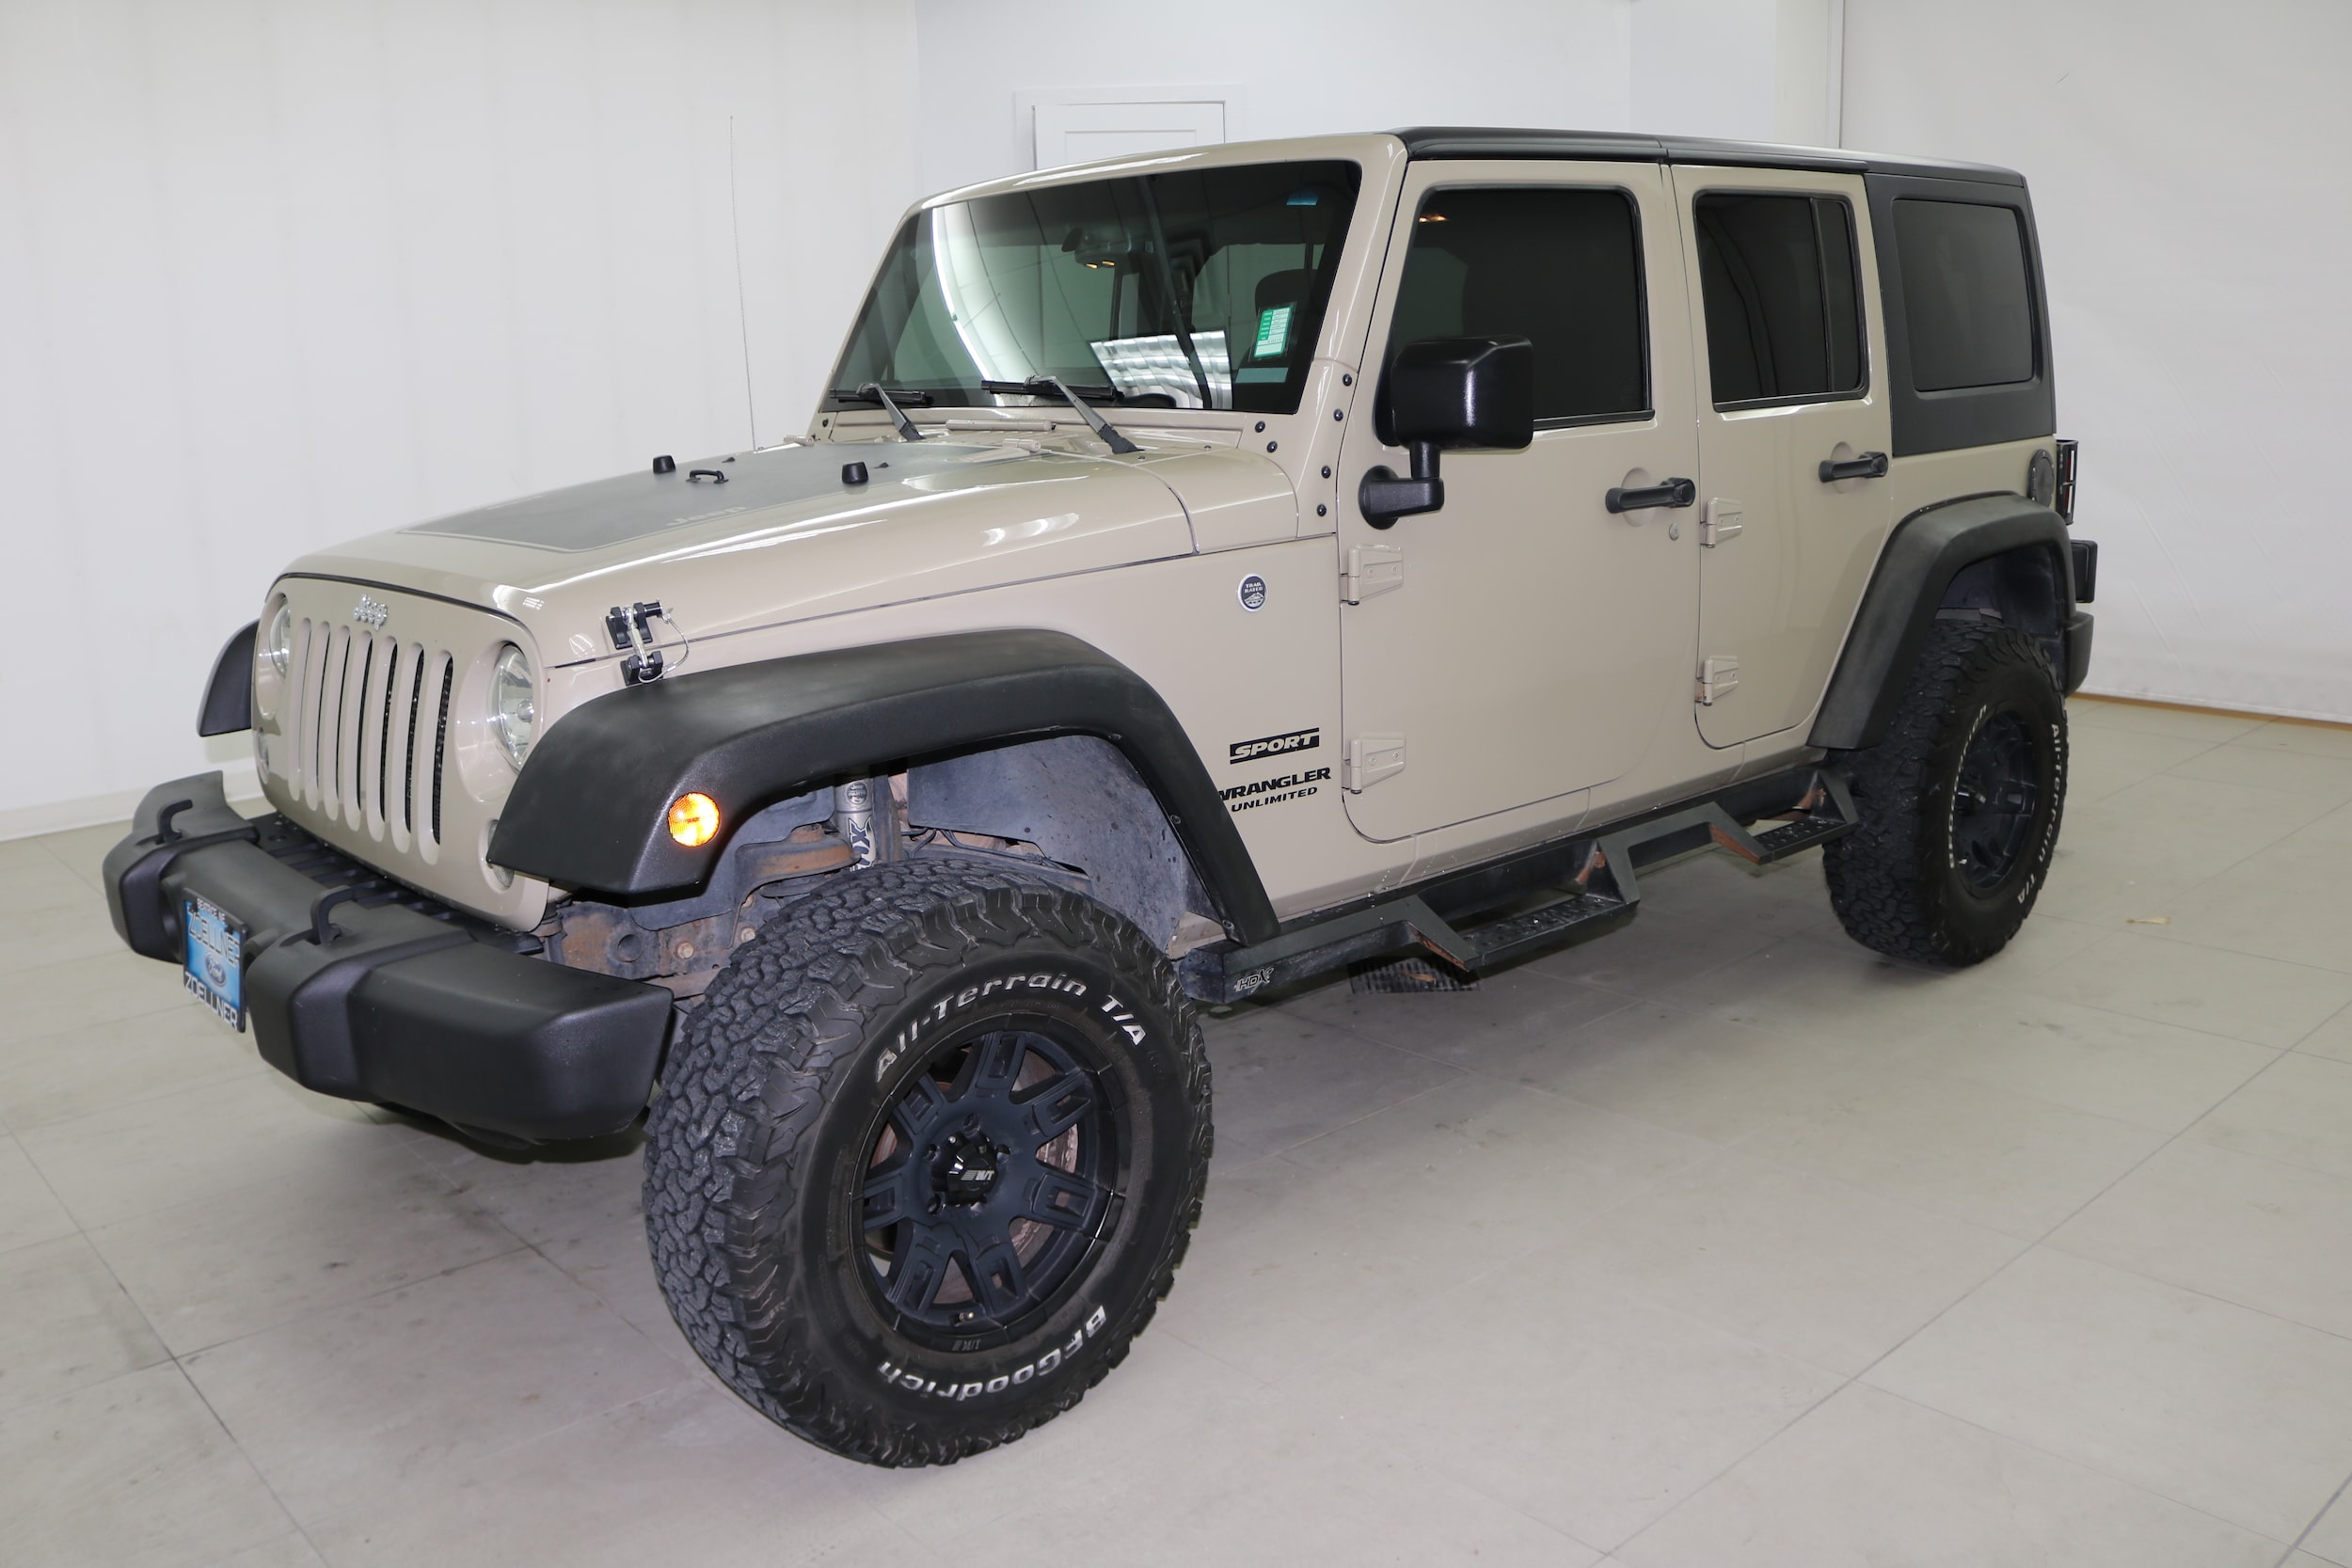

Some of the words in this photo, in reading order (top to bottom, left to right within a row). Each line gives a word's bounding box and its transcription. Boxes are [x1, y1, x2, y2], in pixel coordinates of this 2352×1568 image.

[353, 594, 389, 630] Jeep
[1231, 734, 1317, 758] SPORT
[1232, 786, 1318, 813] UNLIMITED
[184, 971, 238, 1031] ZOELLNER
[876, 972, 1088, 1083] All-Terrain
[878, 1305, 1107, 1402] BFGoodrich
